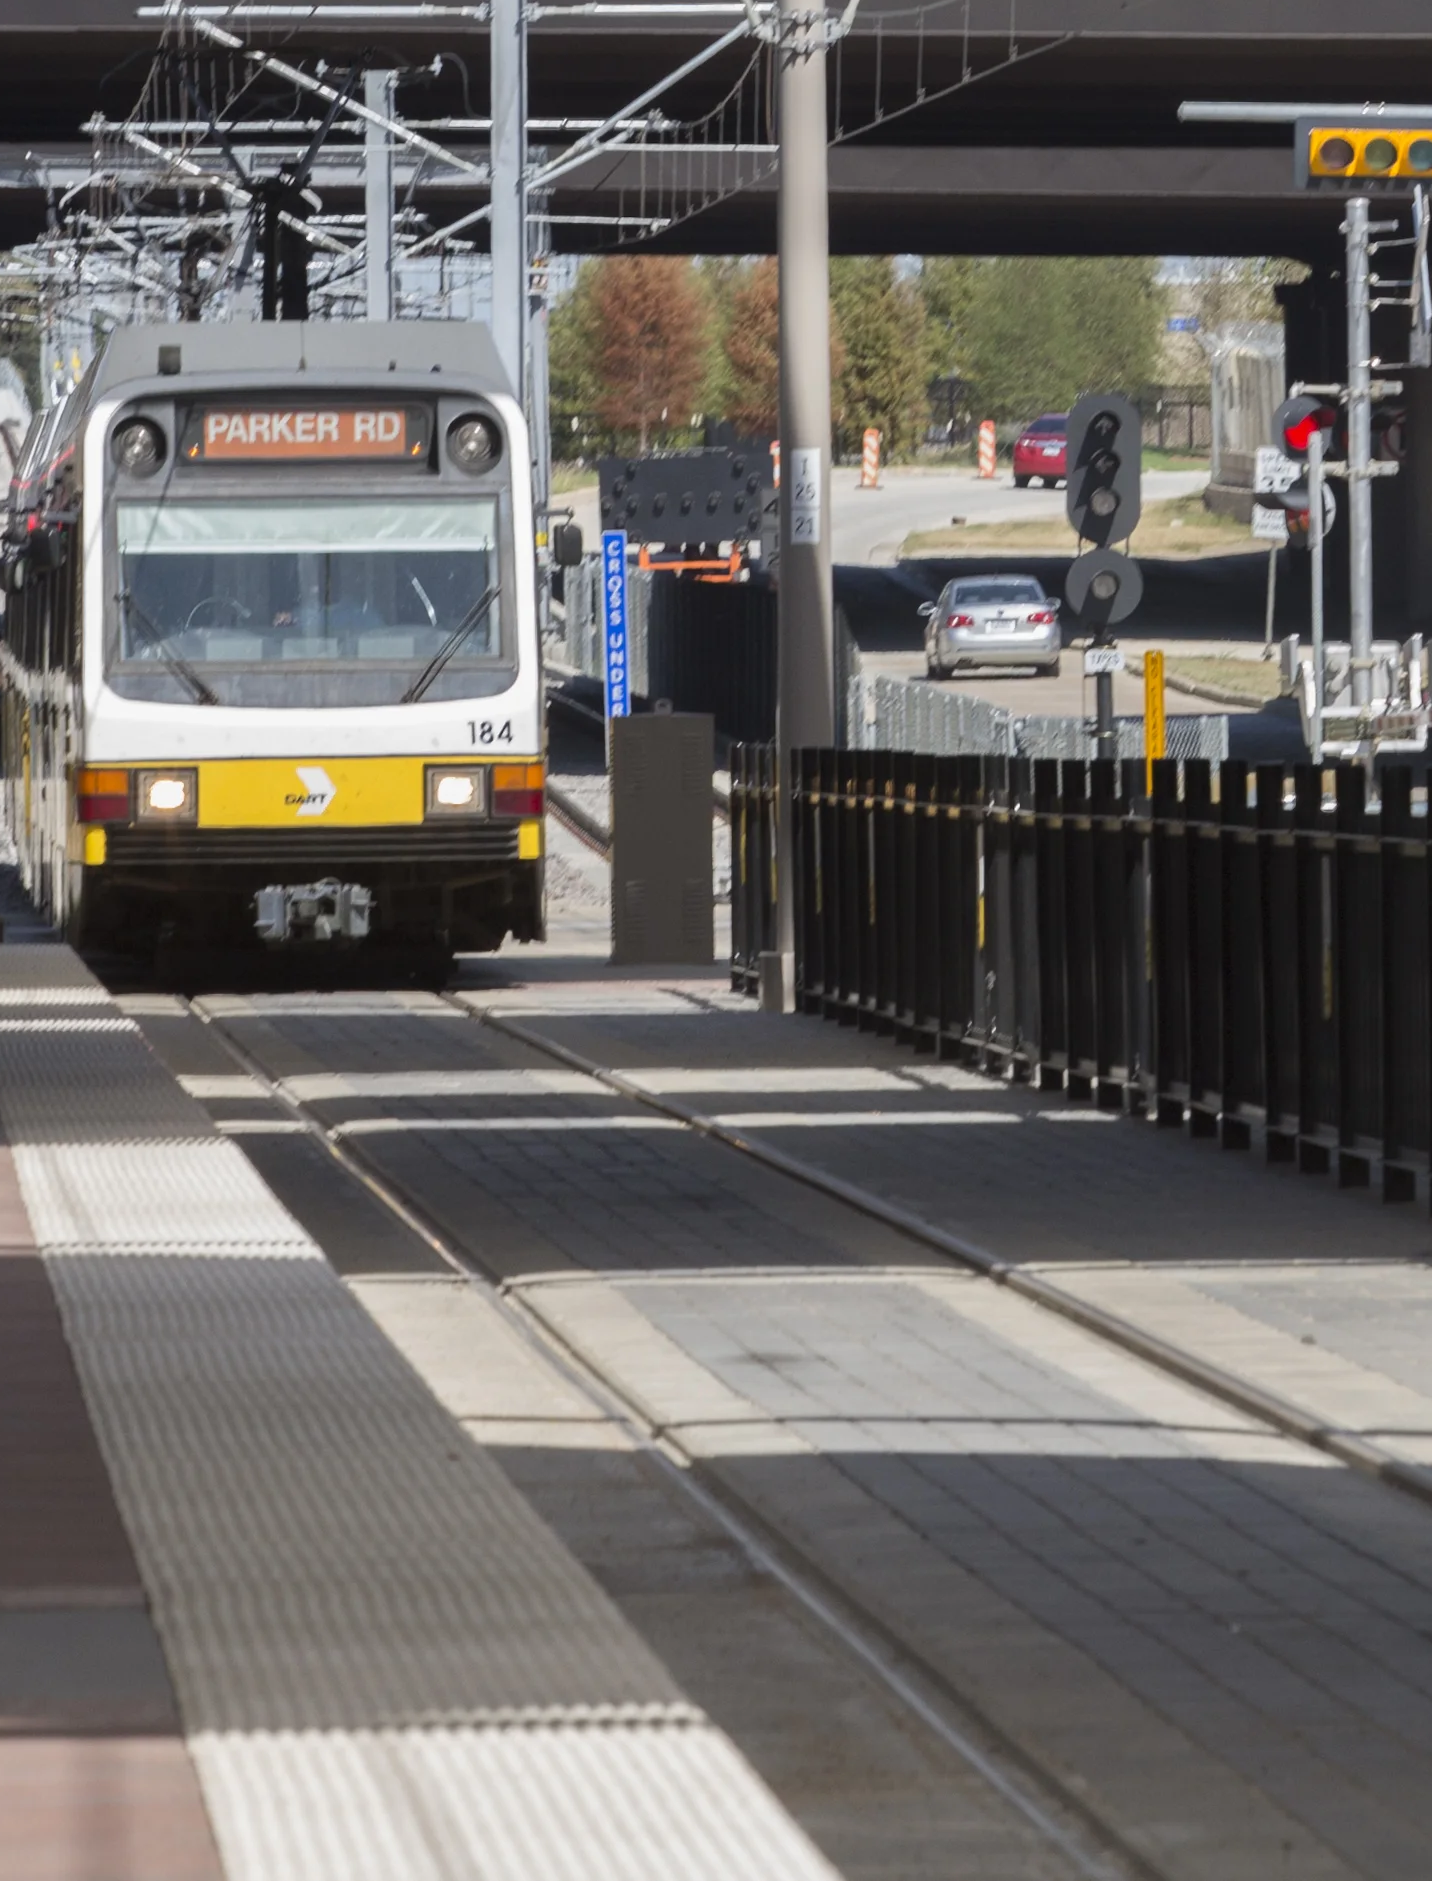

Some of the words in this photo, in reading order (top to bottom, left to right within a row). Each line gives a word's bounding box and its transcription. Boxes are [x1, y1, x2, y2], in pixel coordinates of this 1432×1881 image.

[208, 412, 340, 444] PARKER
[354, 411, 401, 443] RD
[607, 539, 623, 626] CROSS
[609, 632, 625, 717] UNDER
[467, 720, 513, 745] 184
[285, 793, 328, 806] DART
